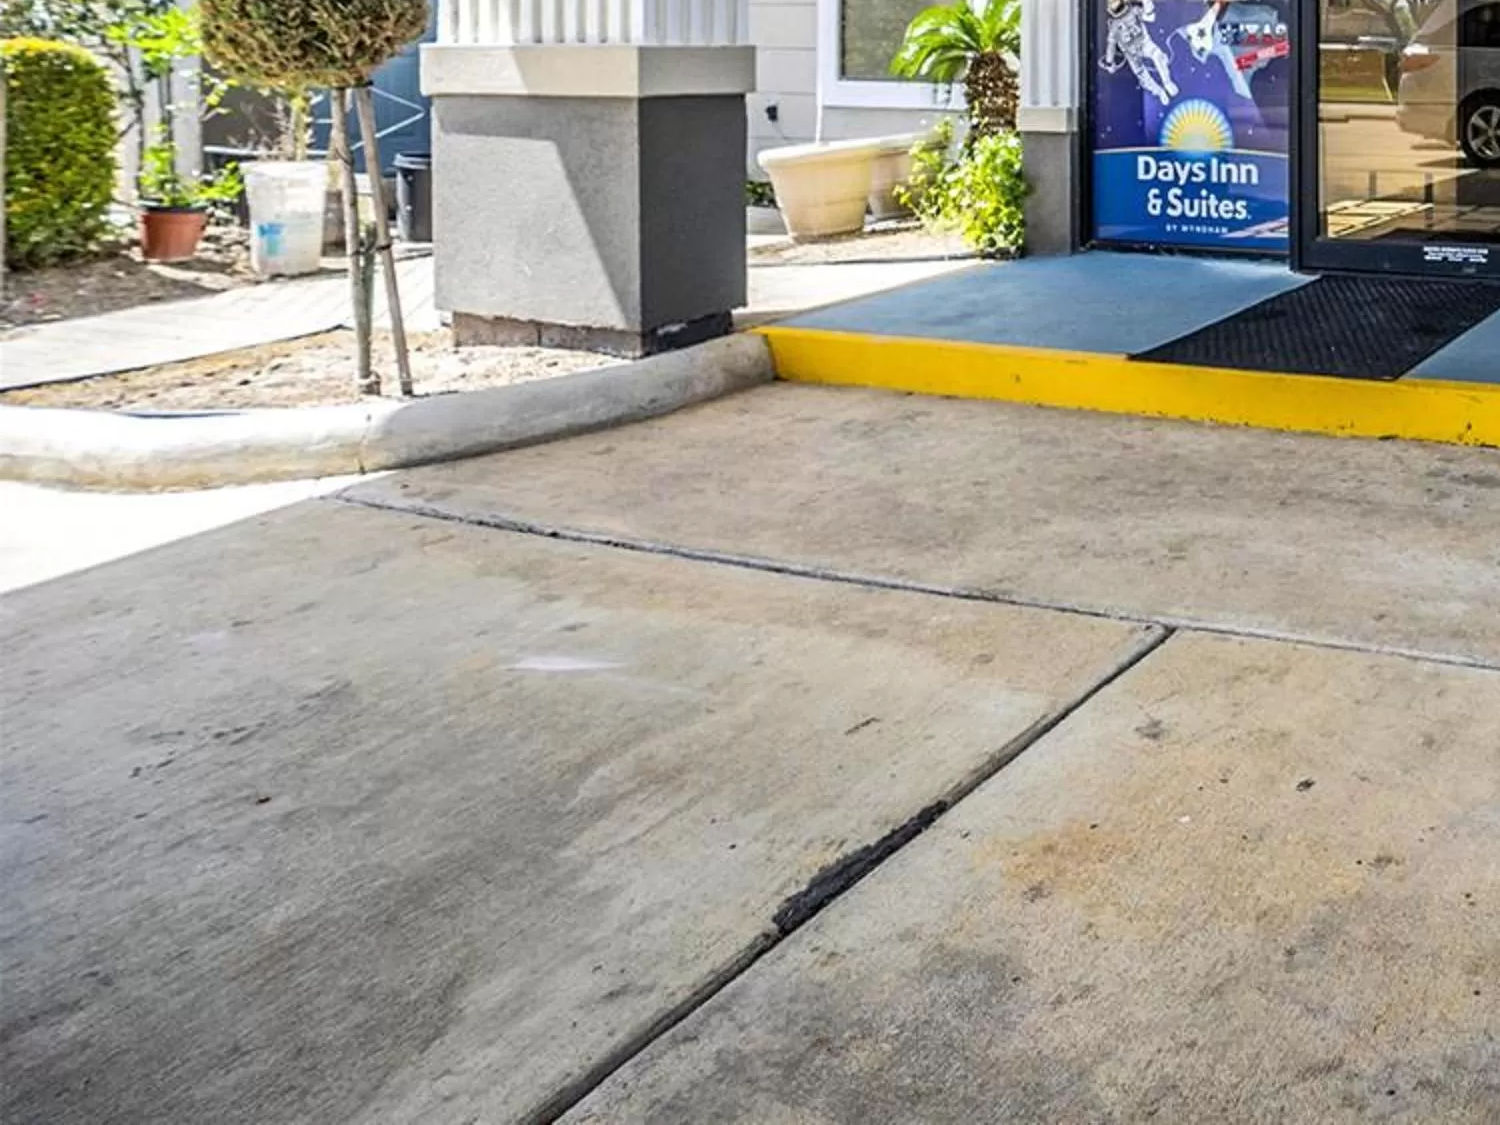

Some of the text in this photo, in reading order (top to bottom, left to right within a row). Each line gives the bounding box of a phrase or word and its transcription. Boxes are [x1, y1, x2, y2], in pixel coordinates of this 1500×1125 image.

[1136, 155, 1259, 186] Days Inn
[1147, 188, 1162, 216] &
[1165, 222, 1229, 234] BY WYNDHAM
